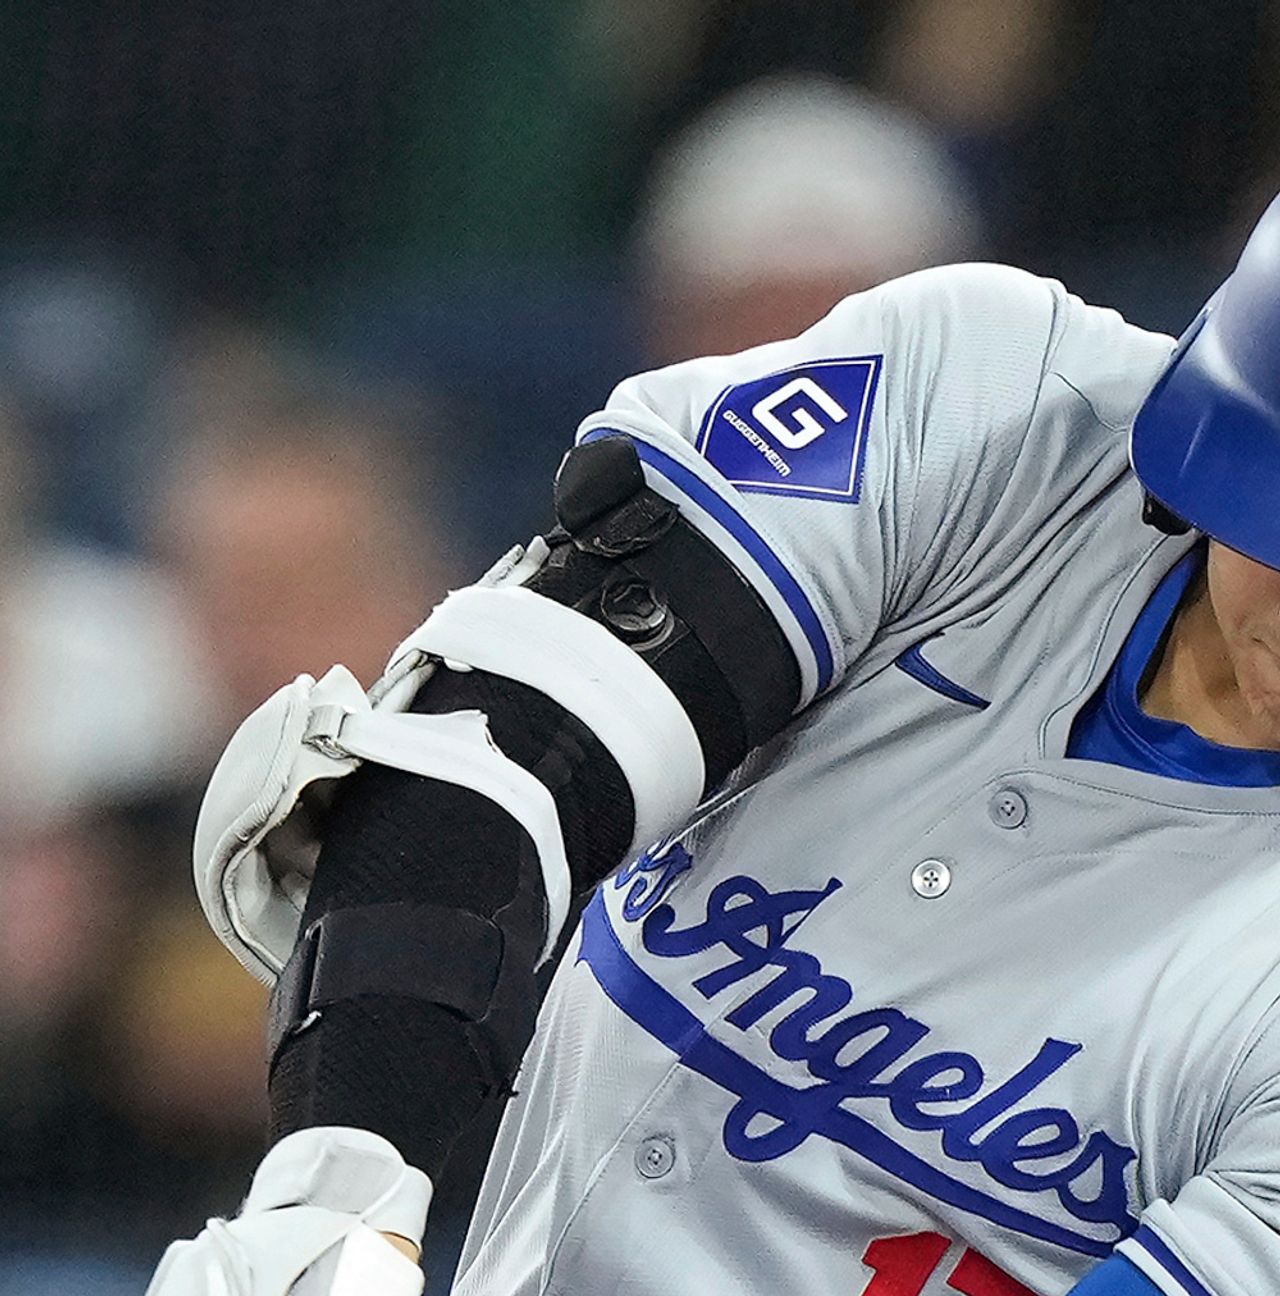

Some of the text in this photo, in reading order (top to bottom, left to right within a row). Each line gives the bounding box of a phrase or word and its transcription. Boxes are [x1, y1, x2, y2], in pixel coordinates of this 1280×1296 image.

[722, 409, 792, 477] GUGGENHEIM
[751, 377, 849, 450] G
[642, 874, 1139, 1240] Angeles
